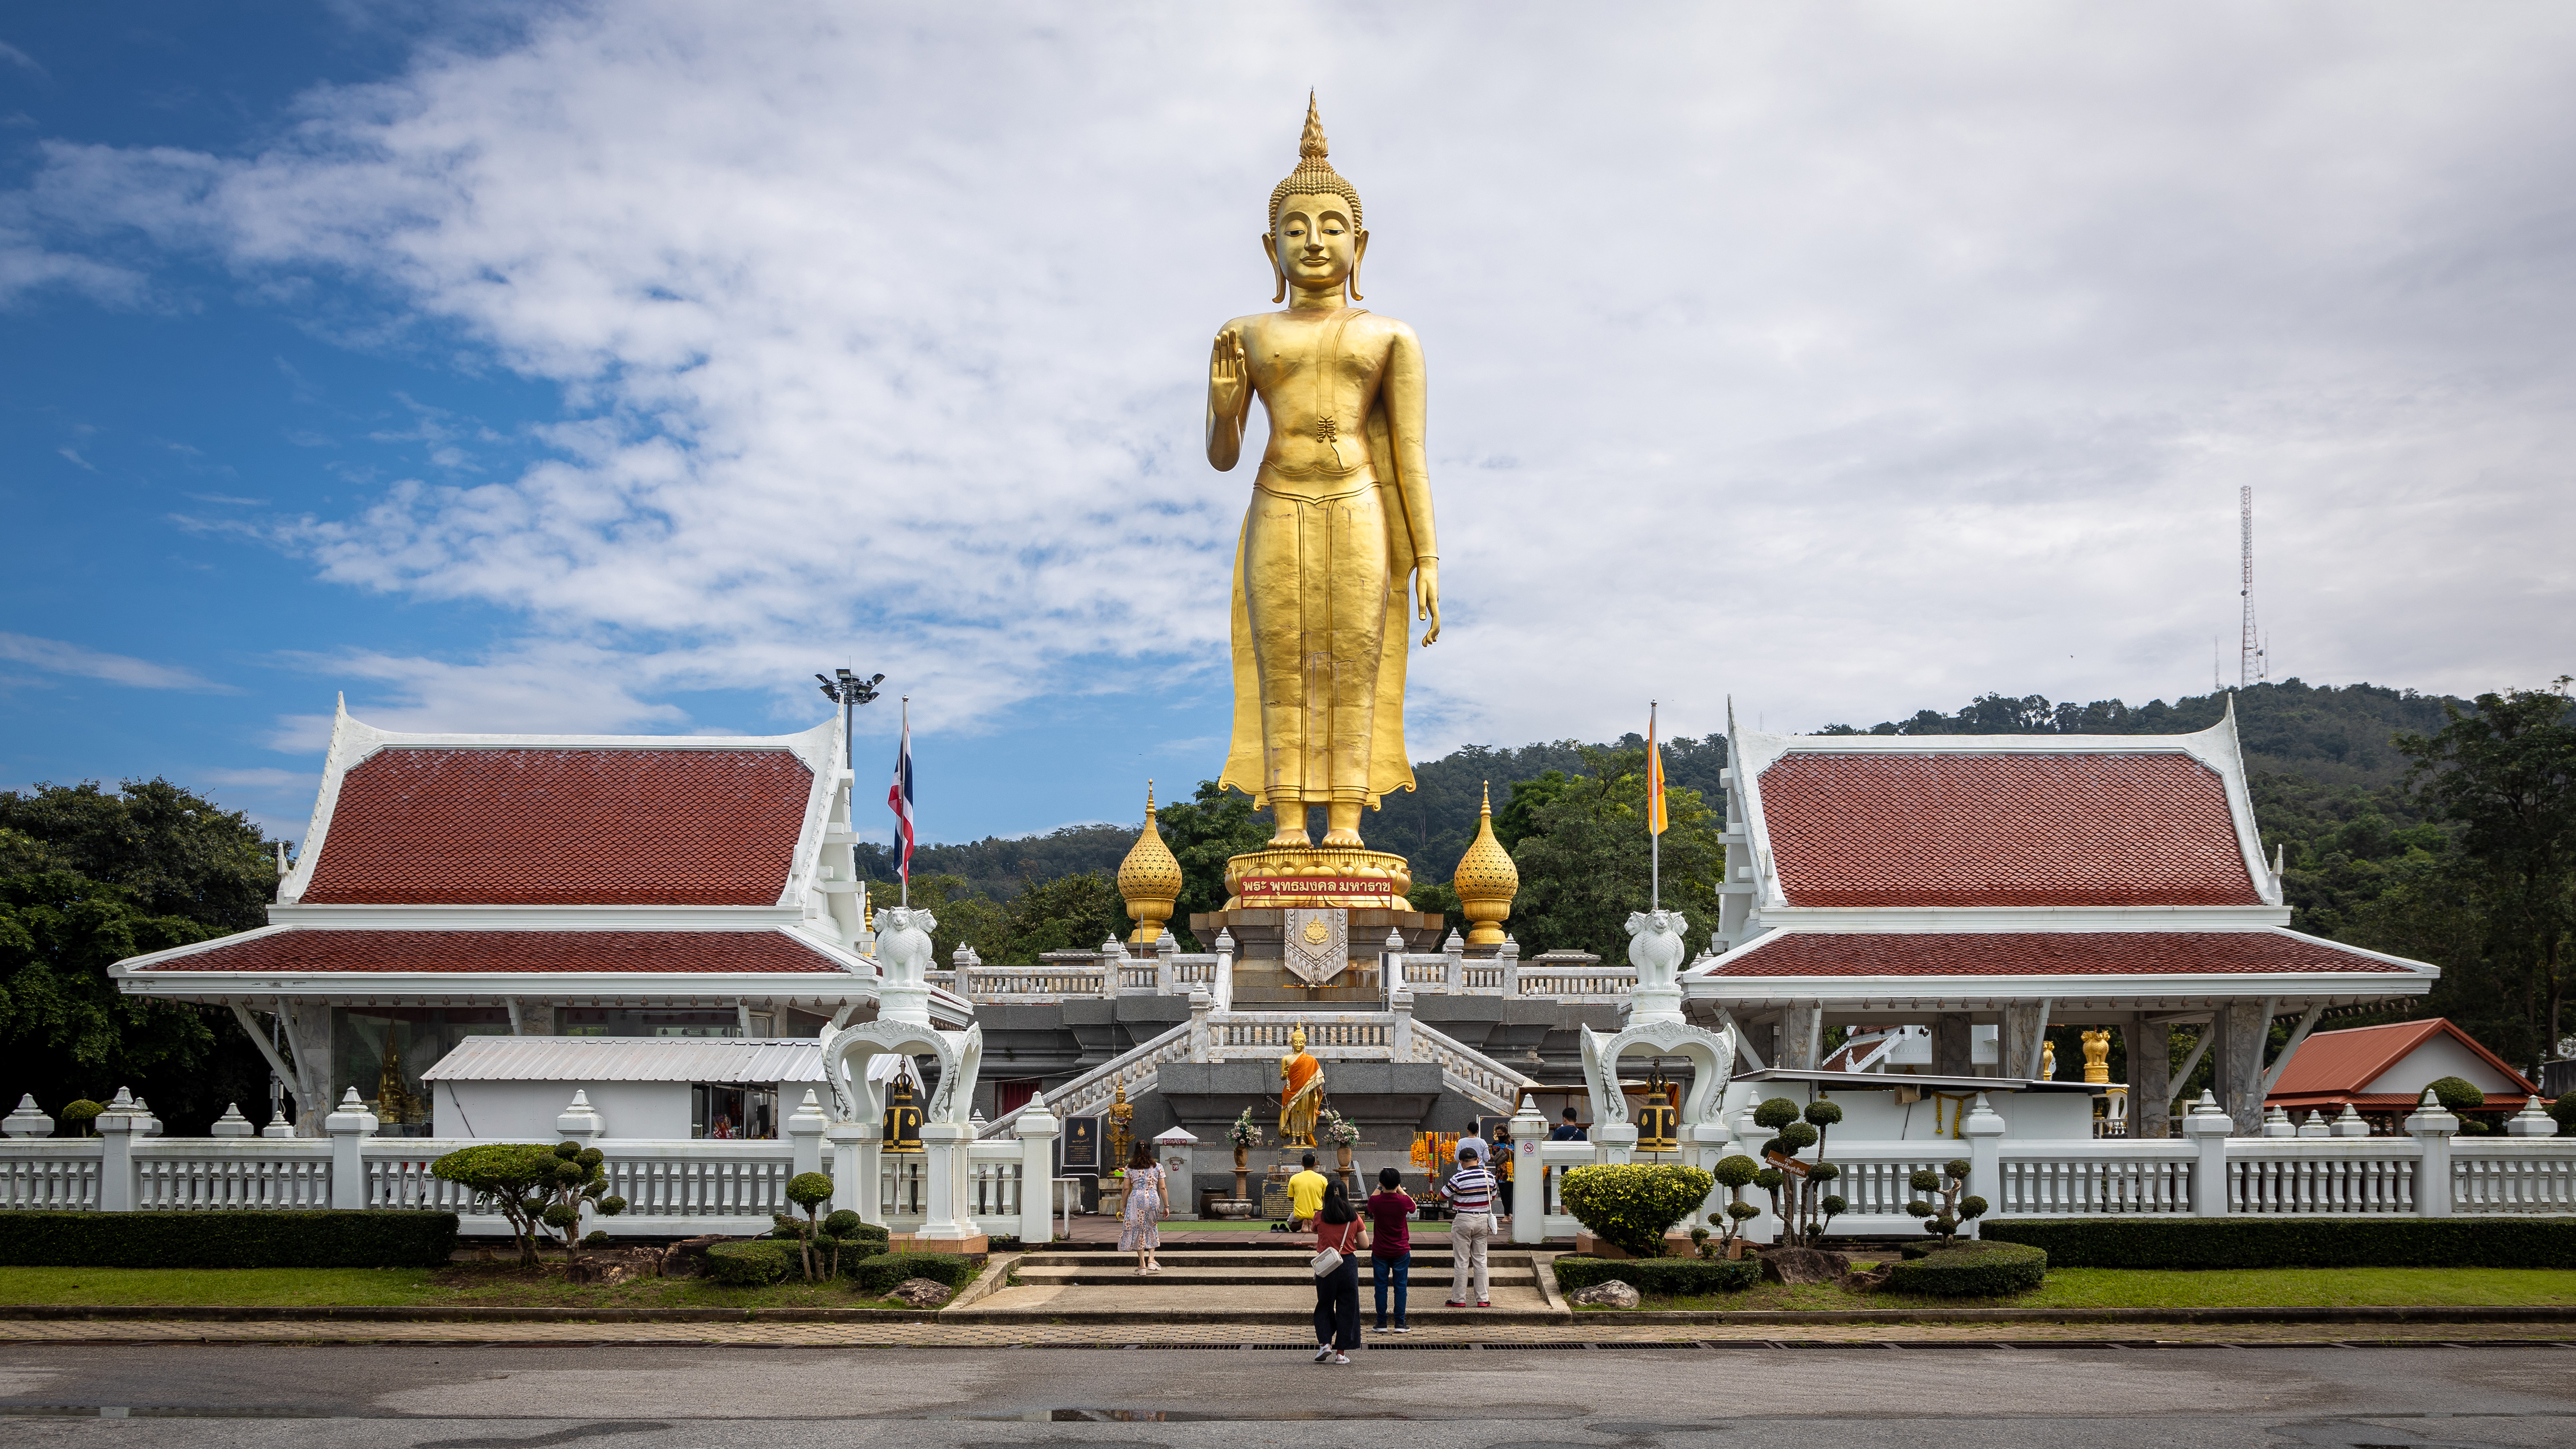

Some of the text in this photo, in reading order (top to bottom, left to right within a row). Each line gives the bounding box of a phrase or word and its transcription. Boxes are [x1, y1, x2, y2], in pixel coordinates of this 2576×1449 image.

[1243, 881, 1391, 896] พระ พุทธมงคล มหาราช
[1768, 1157, 1784, 1167] Siamese
[1784, 1163, 1796, 1172] Rough
